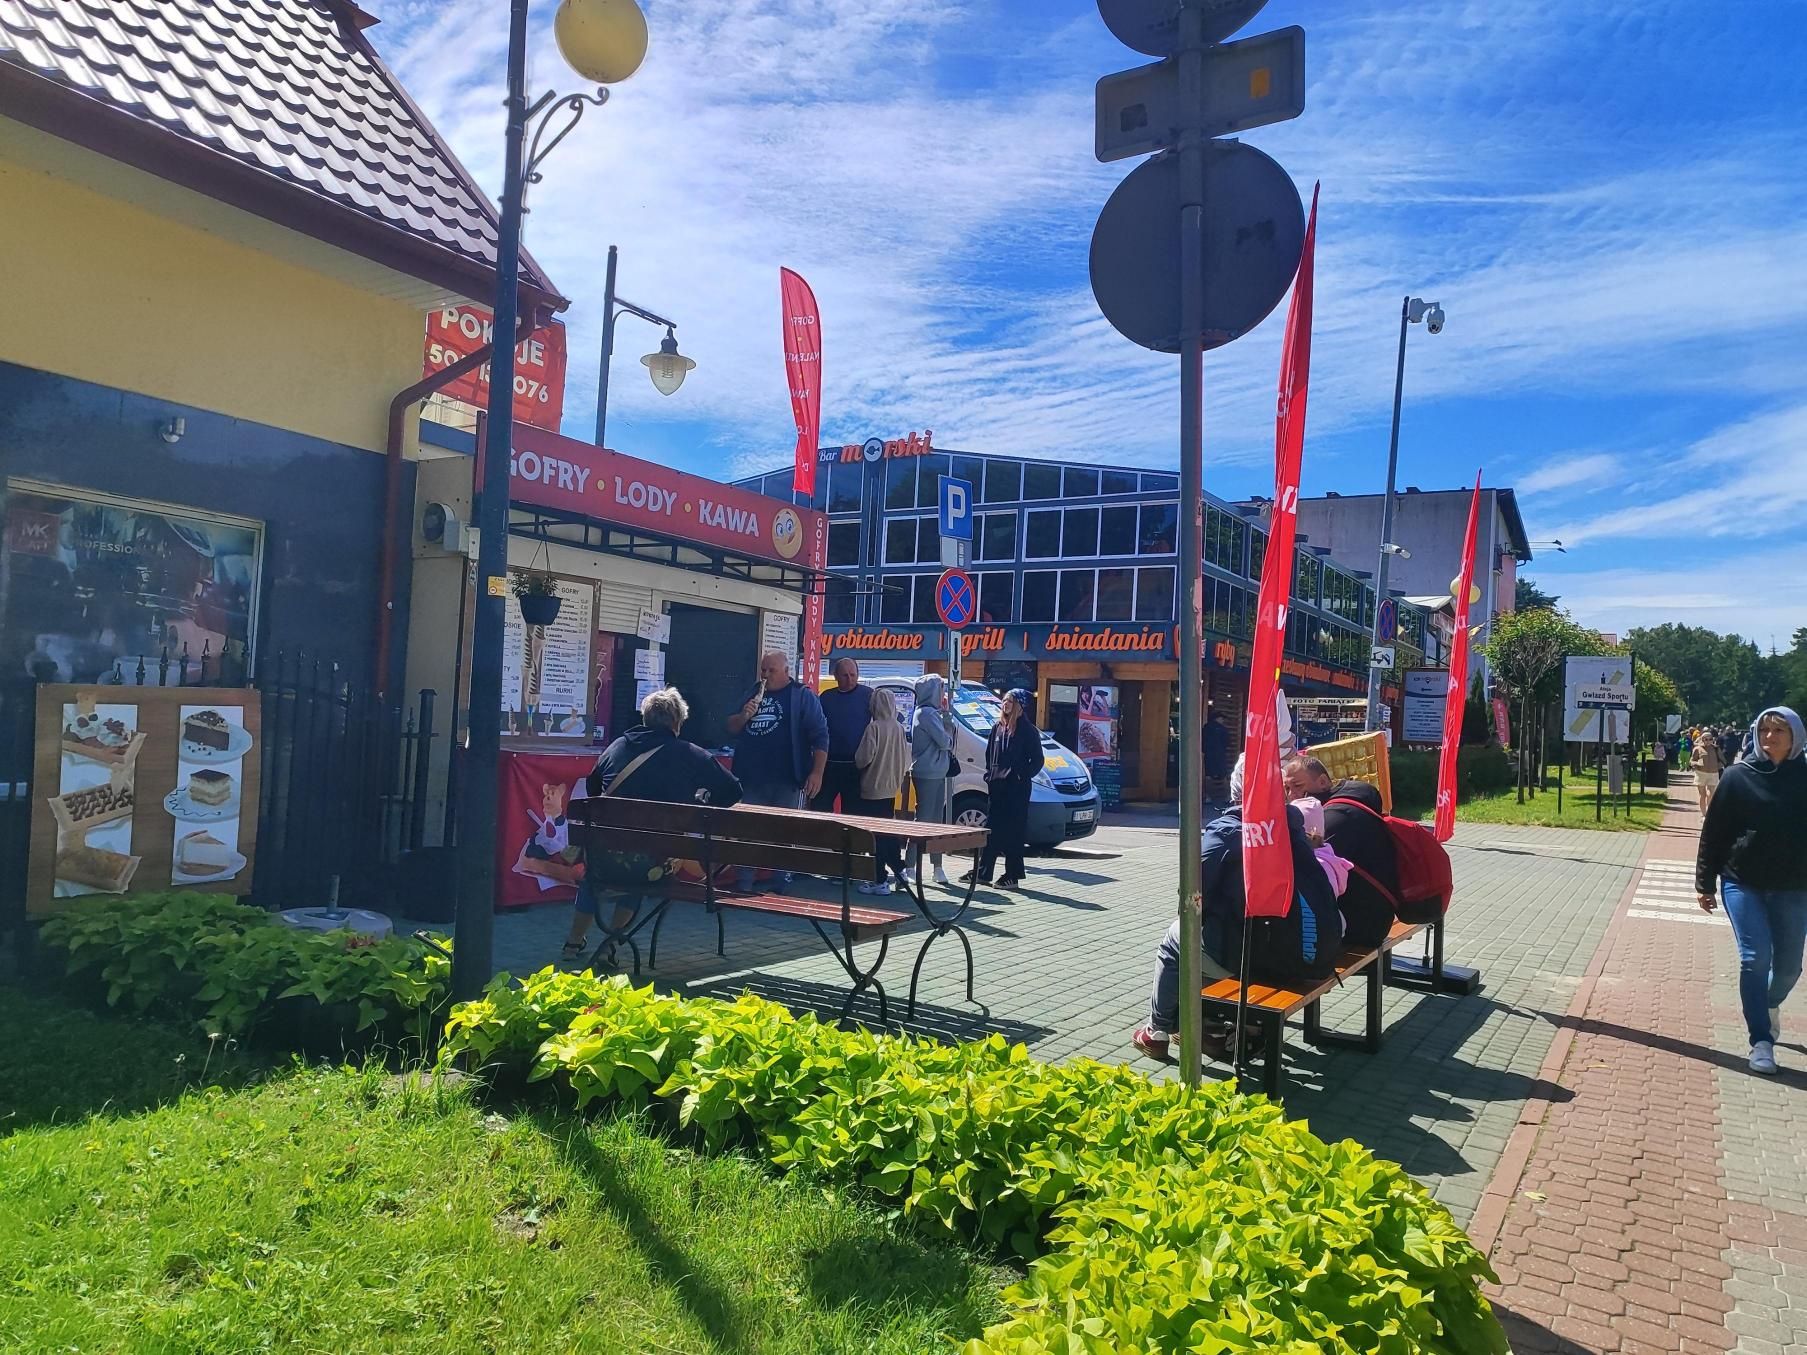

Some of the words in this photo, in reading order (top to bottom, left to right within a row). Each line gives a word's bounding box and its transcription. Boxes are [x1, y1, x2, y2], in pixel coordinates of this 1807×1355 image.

[818, 449, 838, 462] Bar
[614, 476, 678, 516] LODY
[698, 498, 761, 538] KAWA
[947, 484, 967, 530] P
[835, 628, 925, 651] obiadowe
[961, 627, 1006, 657] grill
[1045, 624, 1166, 651] śniadania
[807, 639, 816, 685] KAWA
[1582, 691, 1606, 699] Gwiazd
[1607, 692, 1629, 701] Sportu
[1242, 819, 1275, 848] ERY
